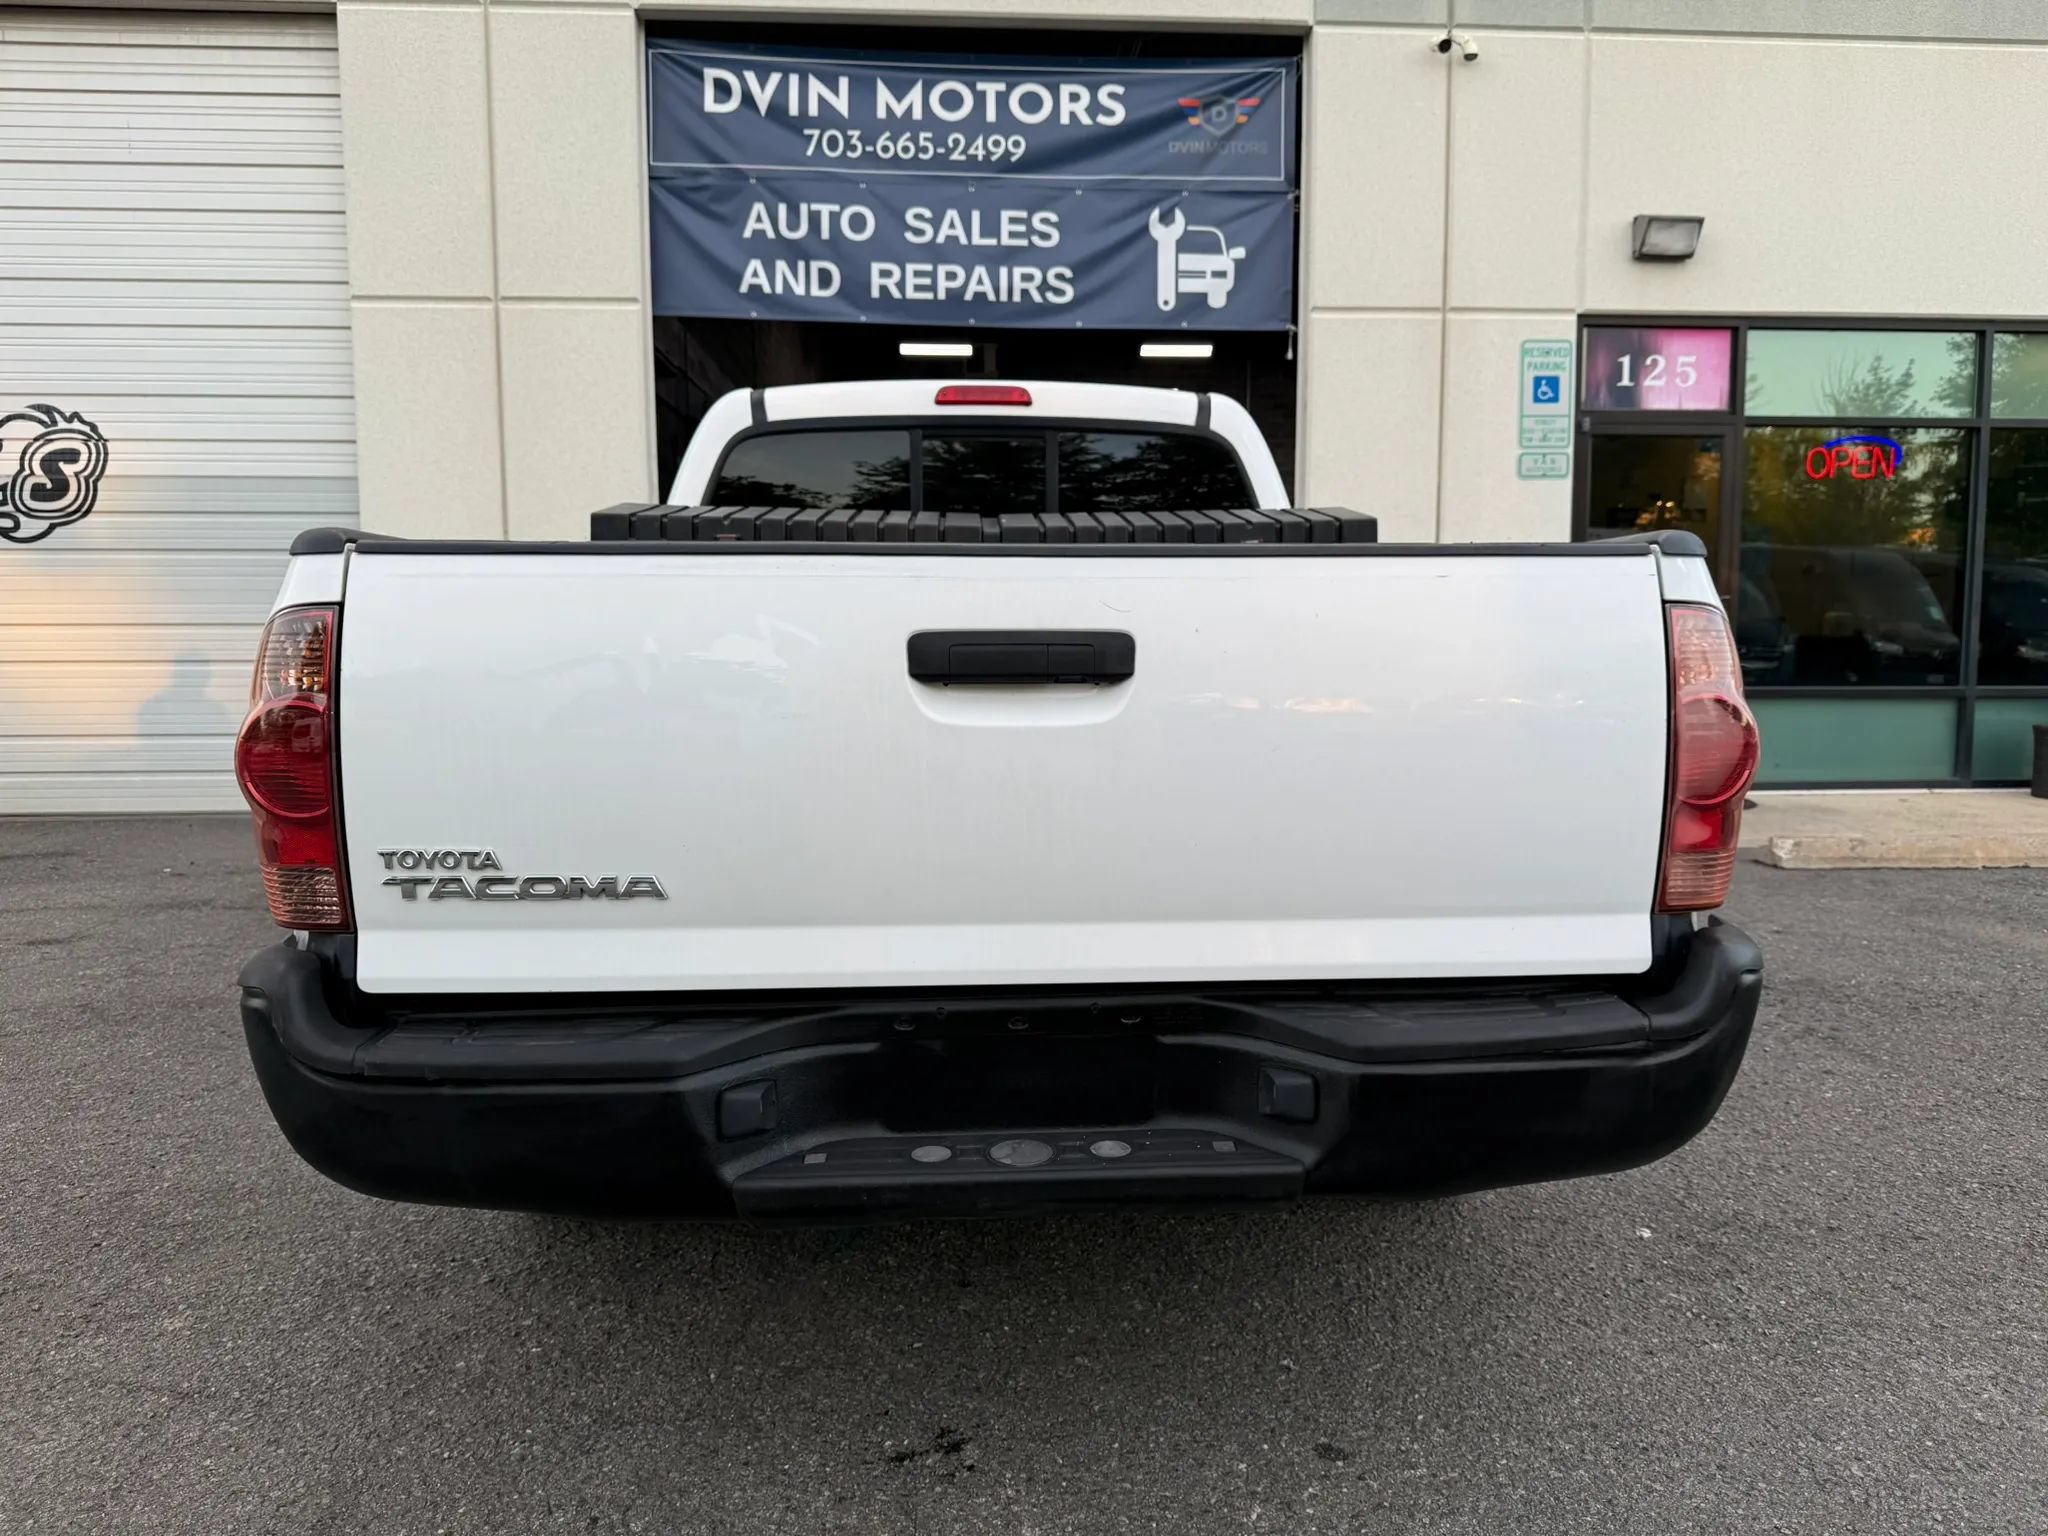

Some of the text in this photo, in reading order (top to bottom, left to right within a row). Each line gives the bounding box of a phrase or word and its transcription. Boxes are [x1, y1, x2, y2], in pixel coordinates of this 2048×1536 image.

[703, 67, 1127, 126] DVIN MOTORS
[803, 129, 1027, 162] 703-665-2499
[742, 202, 1060, 248] AUTO SALES
[739, 259, 1075, 304] AND REPAIRS
[1523, 347, 1570, 358] RESERVED
[1527, 361, 1567, 371] PARKING
[1615, 353, 1698, 388] 125
[1806, 447, 1896, 480] OPEN
[377, 847, 502, 870] TOYOTA
[380, 874, 668, 900] TACOMA
